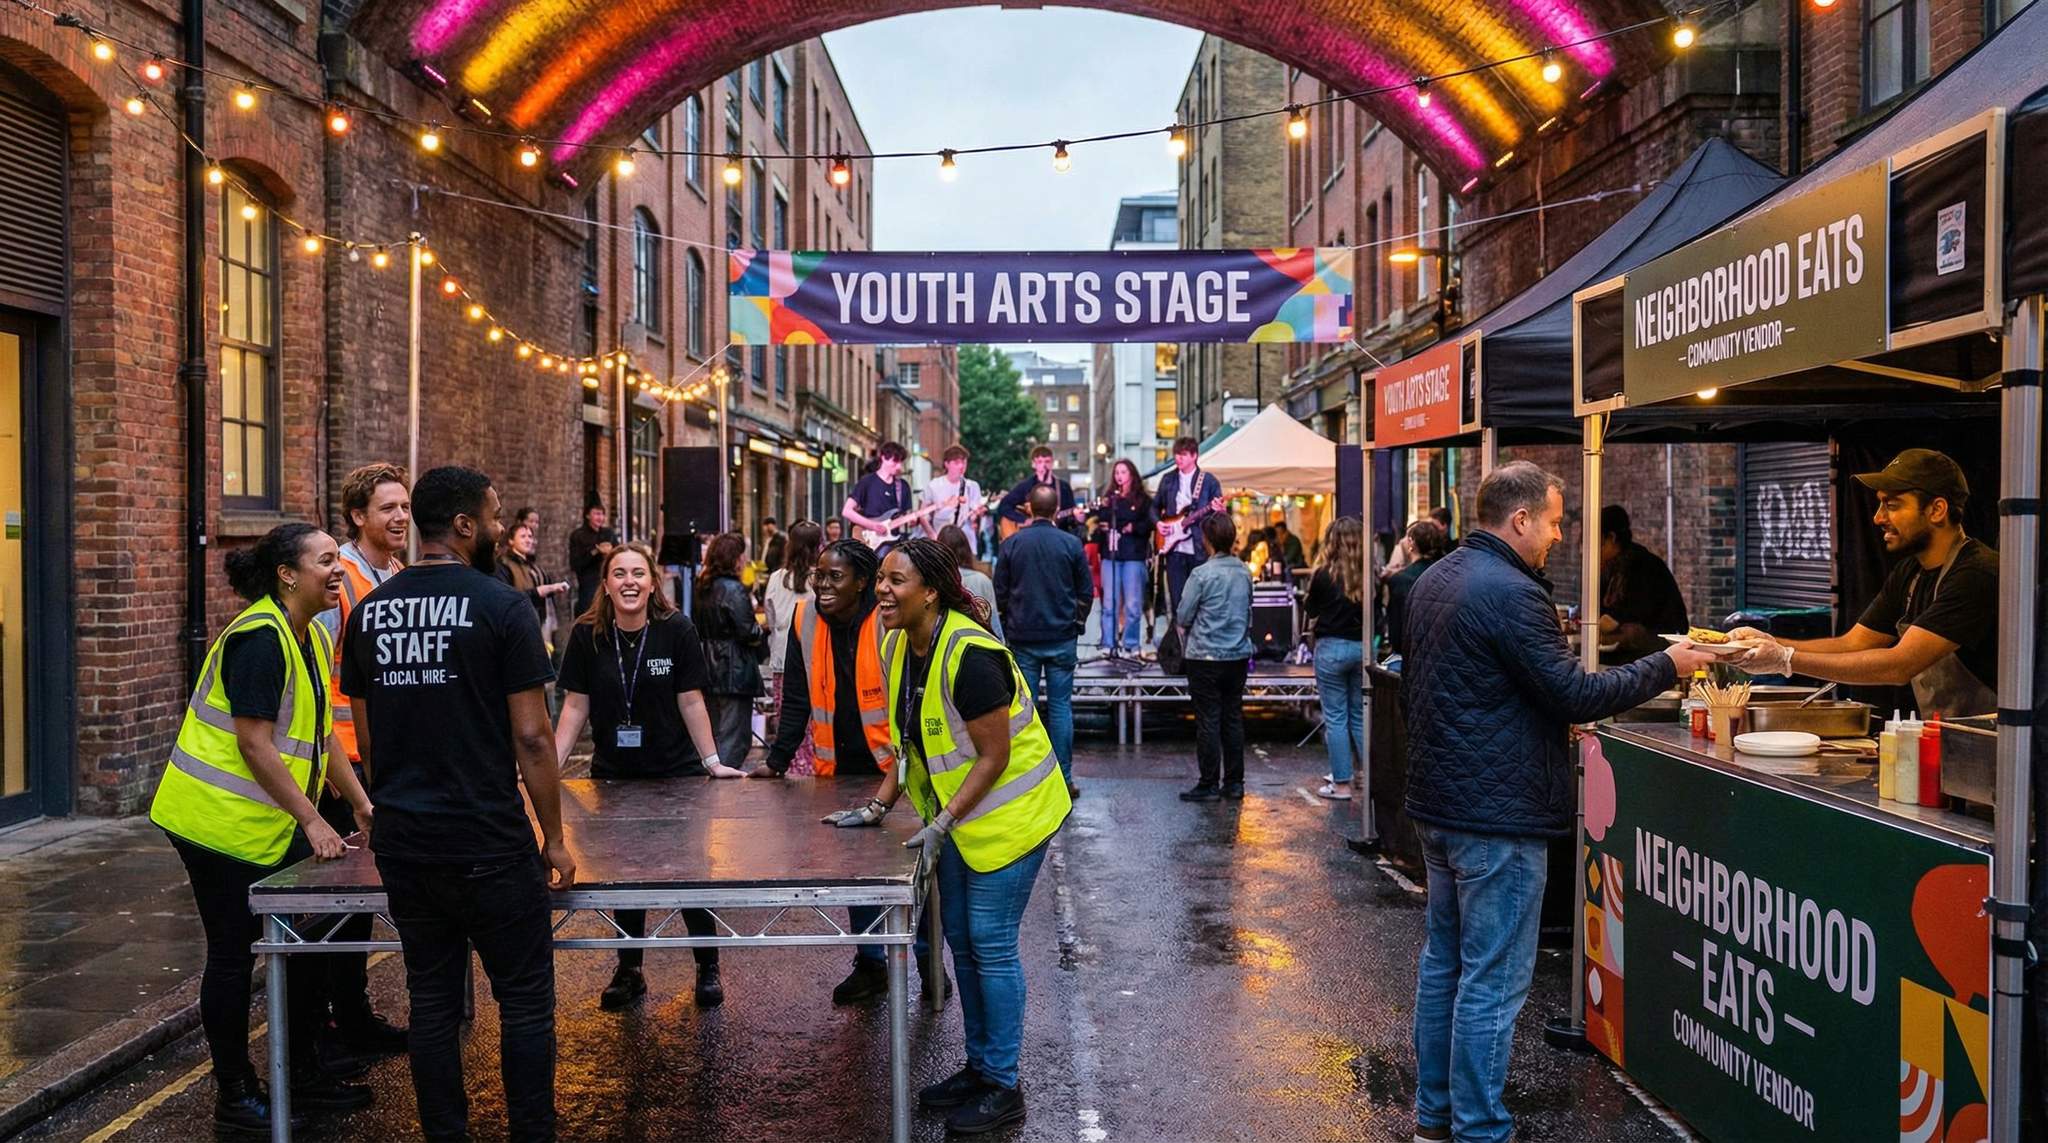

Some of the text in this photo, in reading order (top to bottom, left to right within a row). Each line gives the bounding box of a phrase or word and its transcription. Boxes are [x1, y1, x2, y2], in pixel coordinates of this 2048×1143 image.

[831, 270, 1251, 325] YOUTH ARTS STAGE
[1635, 213, 1864, 349] NEIGHBORHOOD EATS
[1687, 319, 1782, 368] COMMUNITY VENDOR
[1405, 373, 1425, 410] ARTS
[1425, 363, 1450, 405] STAGE
[362, 596, 473, 632] FESTIVAL
[376, 630, 452, 665] STAFF
[383, 669, 447, 686] LOCAL HIRE
[1635, 826, 1876, 1006] NEIGHBORHOOD
[1703, 938, 1775, 1046] EATS
[1673, 1009, 1815, 1132] COMMUNITY VENDOR
